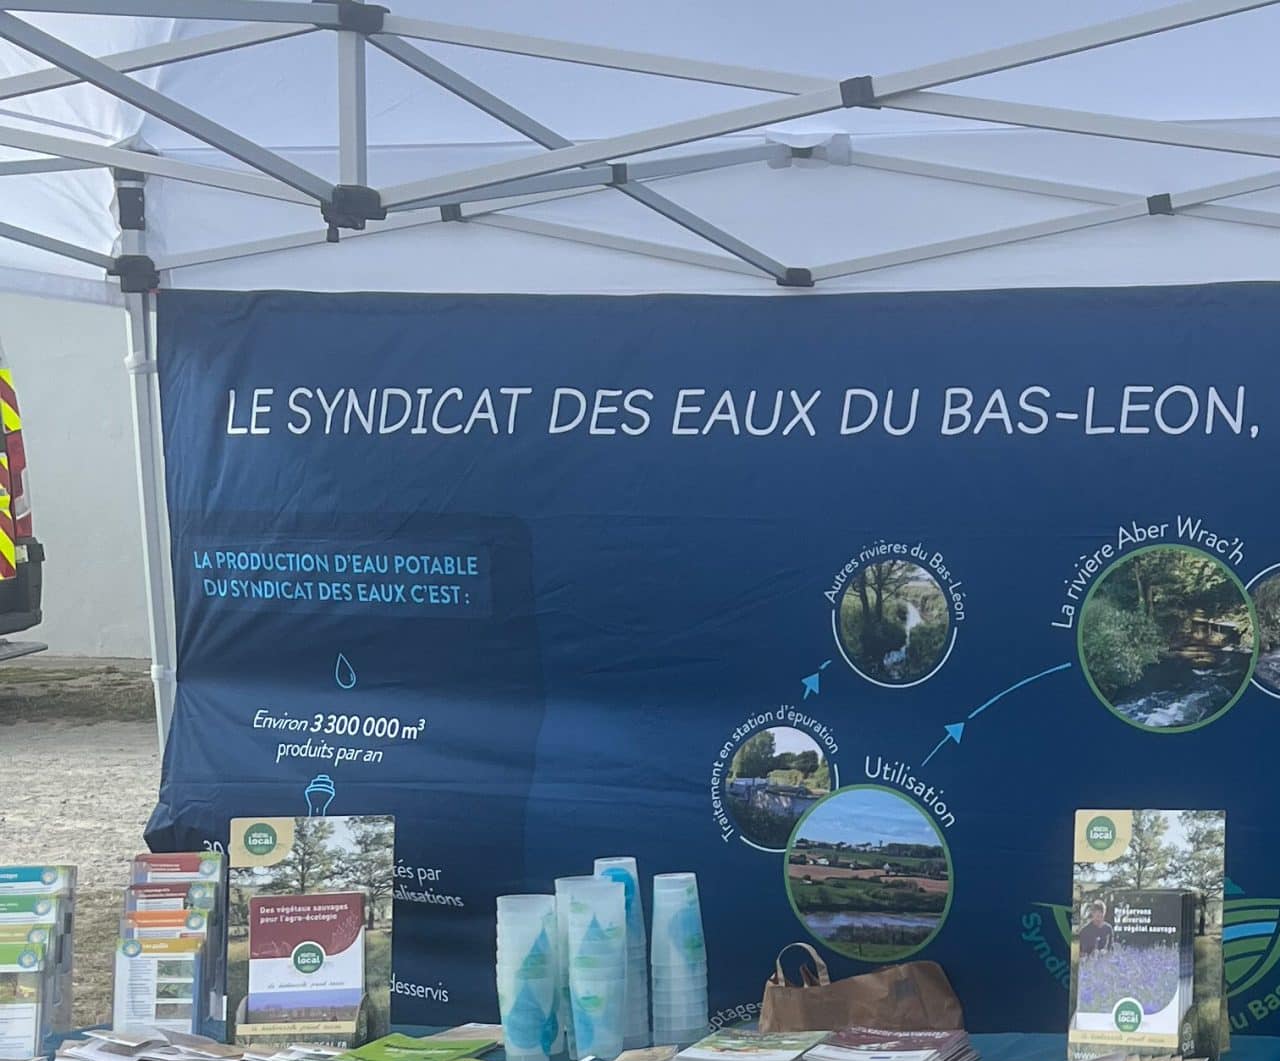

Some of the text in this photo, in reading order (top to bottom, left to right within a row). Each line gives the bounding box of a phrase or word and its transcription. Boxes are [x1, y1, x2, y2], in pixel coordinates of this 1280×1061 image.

[225, 387, 272, 436] LE
[286, 386, 532, 437] SYNDICAT
[547, 387, 652, 437] DES
[671, 387, 821, 438] EAUX
[839, 387, 919, 436] DU
[941, 385, 1260, 440] BAS-LEON,
[193, 551, 479, 575] LA PRODUCTION D'EAU POTABLE
[1051, 515, 1244, 629] La rivière Aber Wrac'h
[204, 579, 460, 604] DU SYNDICAT DES EAUX C'EST
[823, 540, 966, 621] Autres rivières du Bas-Léon
[253, 709, 308, 731] Environ
[276, 738, 383, 766] produits par an
[711, 705, 840, 843] Traitement en station d'épuration
[864, 756, 957, 829] Utilisation
[417, 867, 442, 887] par
[260, 906, 274, 914] Des
[312, 903, 349, 914] sauvages
